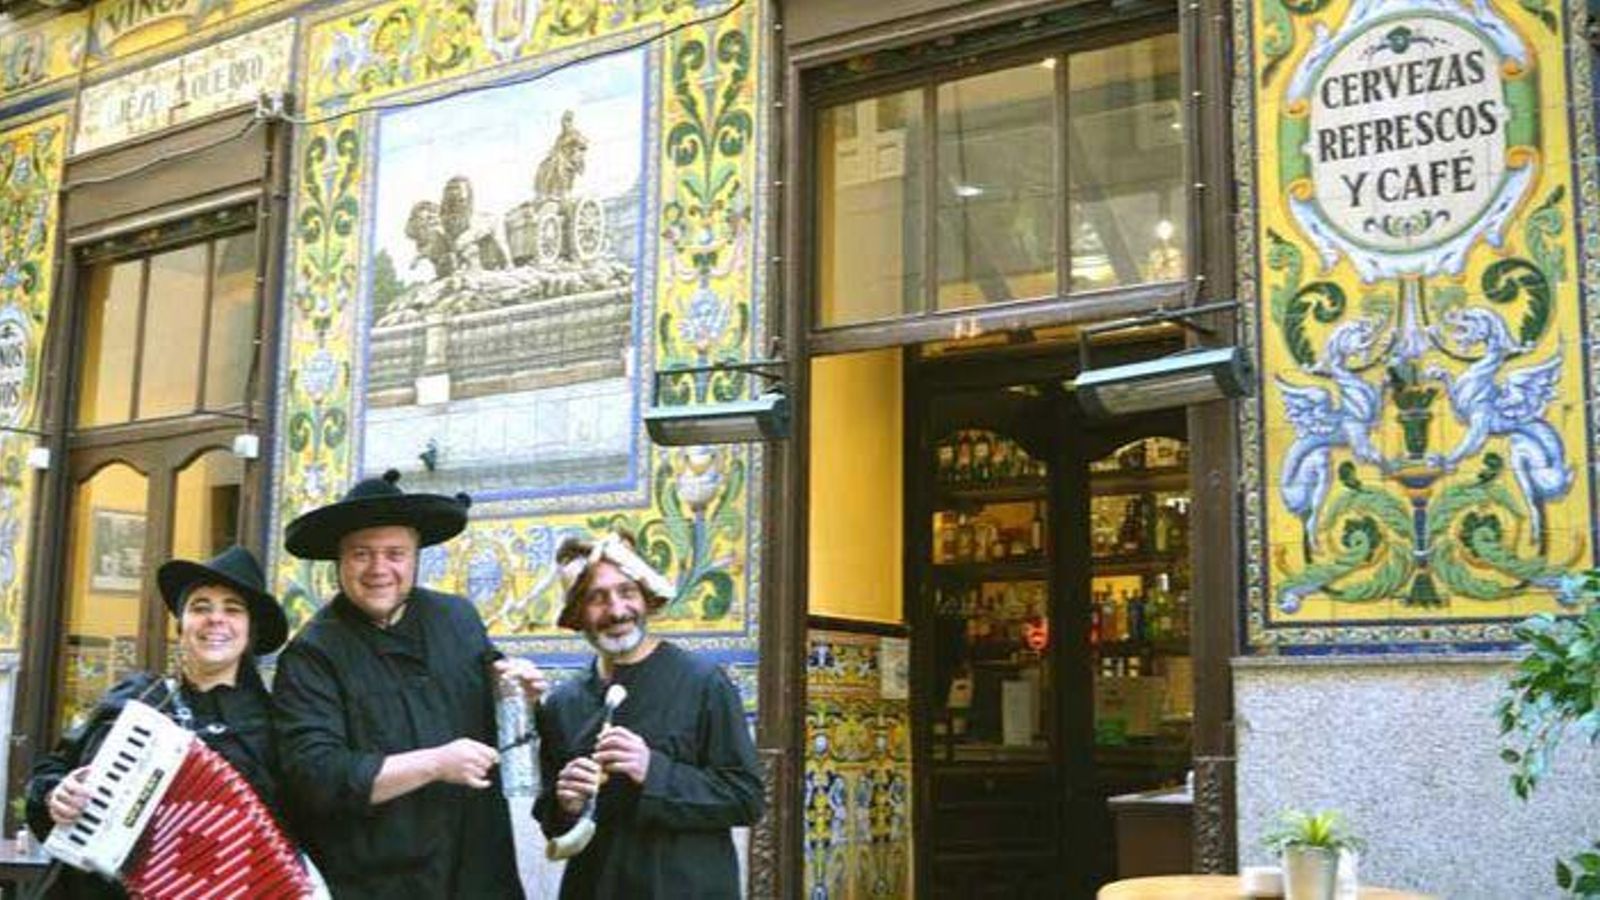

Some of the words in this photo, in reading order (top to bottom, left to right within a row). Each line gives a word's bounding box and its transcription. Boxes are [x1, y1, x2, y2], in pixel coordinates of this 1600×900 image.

[1320, 50, 1486, 110] CERVEZAS
[1317, 100, 1498, 163] REFRESCOS
[1341, 172, 1368, 207] Y
[1376, 150, 1476, 203] CAFÉ
